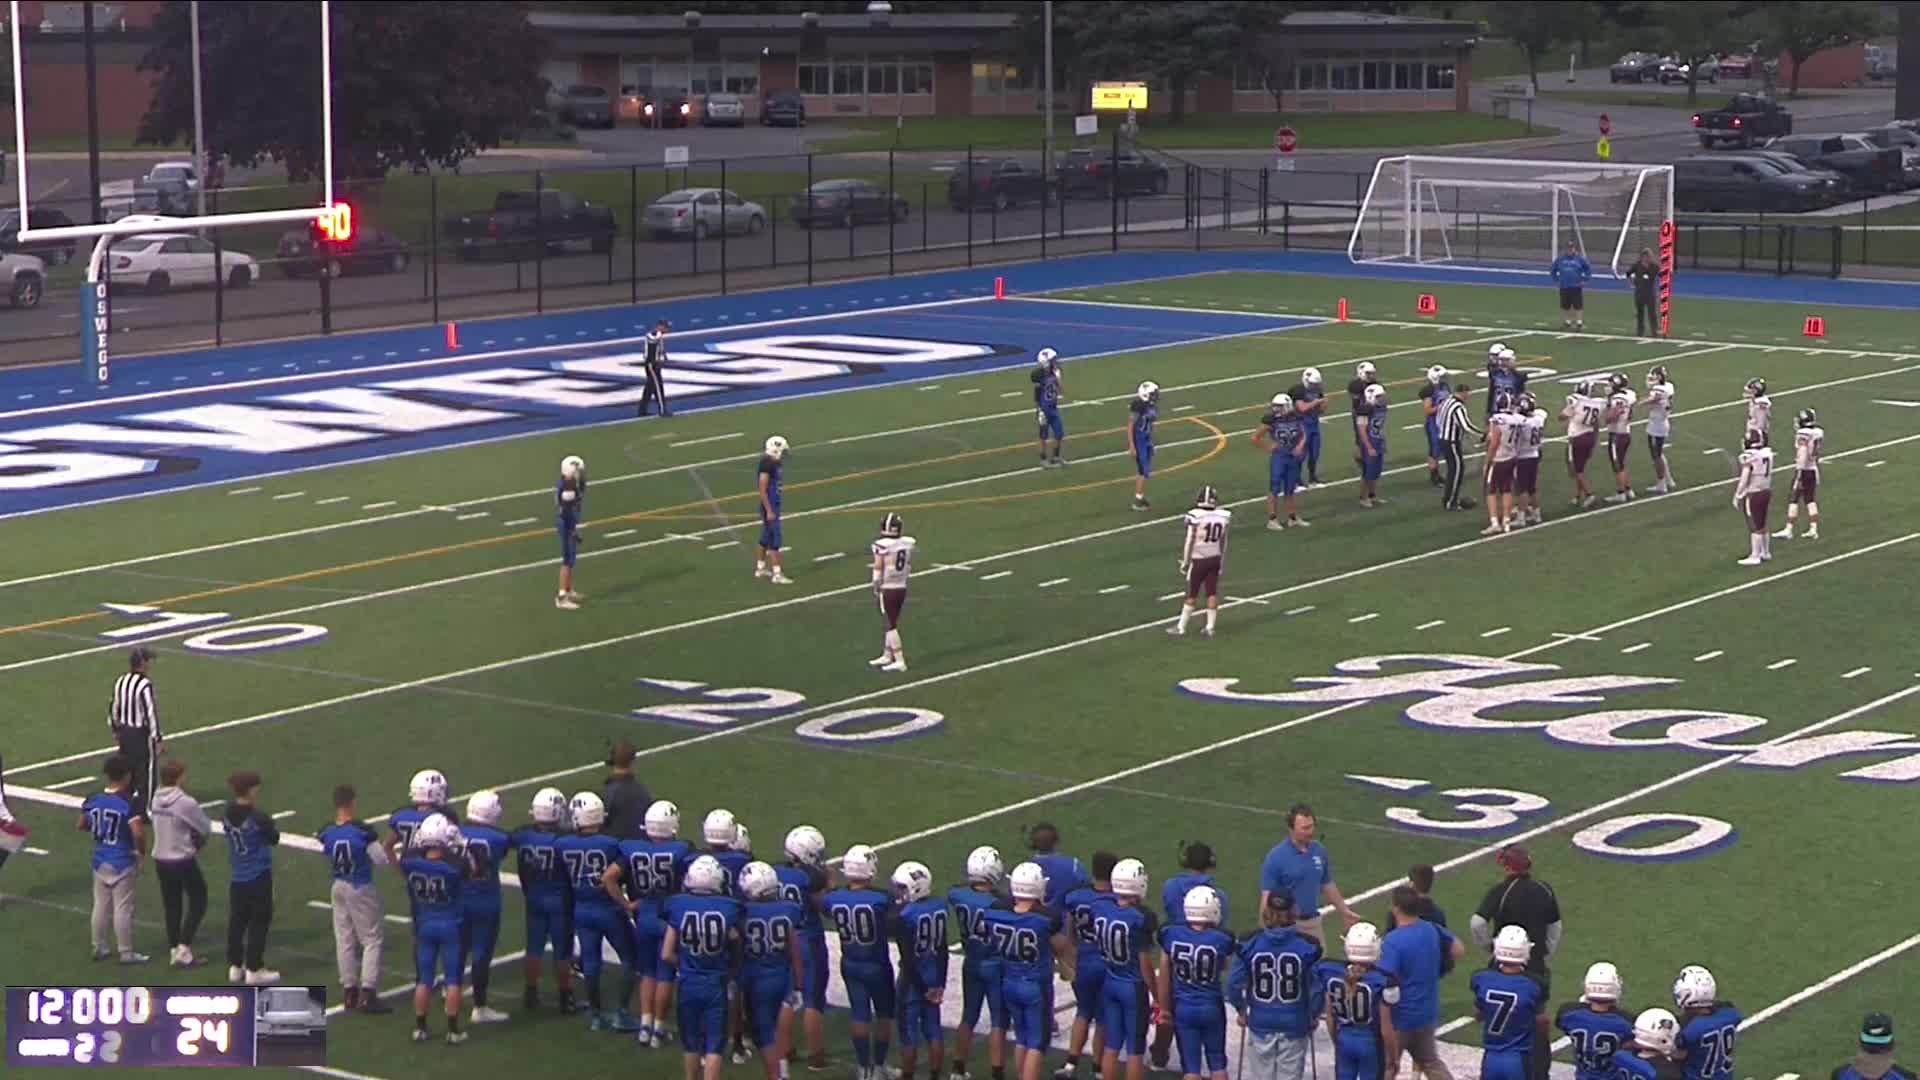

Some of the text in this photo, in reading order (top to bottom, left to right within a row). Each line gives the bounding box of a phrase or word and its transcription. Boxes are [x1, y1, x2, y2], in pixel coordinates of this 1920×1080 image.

[94, 283, 109, 381] OSWEGO
[1203, 521, 1223, 543] 10
[98, 612, 329, 655] 10
[631, 686, 945, 742] 20
[90, 807, 121, 846] 17
[1385, 787, 1734, 858] 30
[332, 839, 354, 879] 4
[630, 851, 675, 894] 65
[680, 910, 726, 957] 40
[992, 923, 1040, 964] 76
[1094, 915, 1130, 966] 10
[1170, 940, 1218, 984] 50
[1251, 951, 1302, 1004] 68
[1484, 989, 1518, 1036] 7
